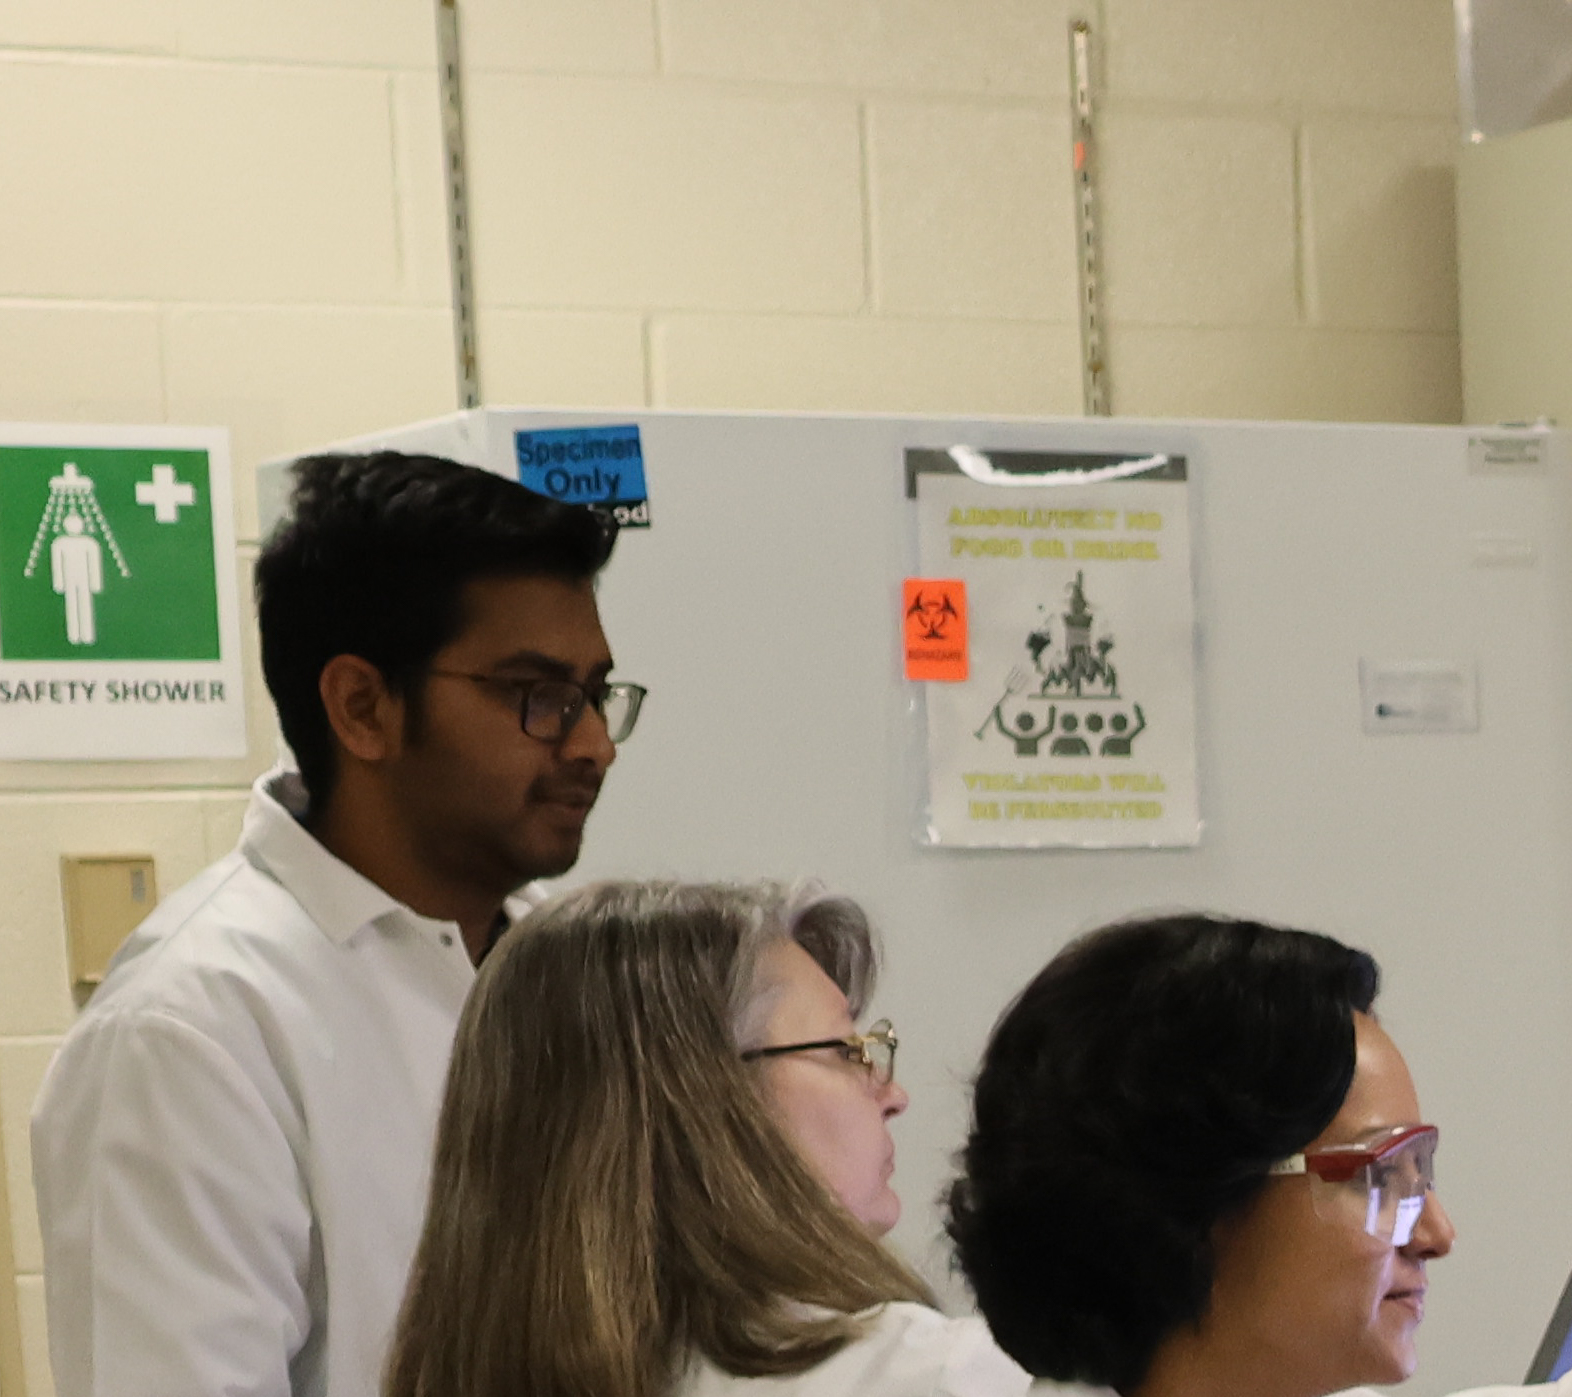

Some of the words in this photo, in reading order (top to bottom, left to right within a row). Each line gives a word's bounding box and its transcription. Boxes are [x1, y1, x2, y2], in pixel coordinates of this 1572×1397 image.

[519, 434, 642, 467] Specimen
[545, 467, 621, 501] Only
[951, 537, 1024, 559] FOOD
[1029, 538, 1068, 559] OR
[1073, 539, 1160, 560] DRINK
[0, 680, 96, 703] SAFETY
[106, 680, 227, 703] SHOWER
